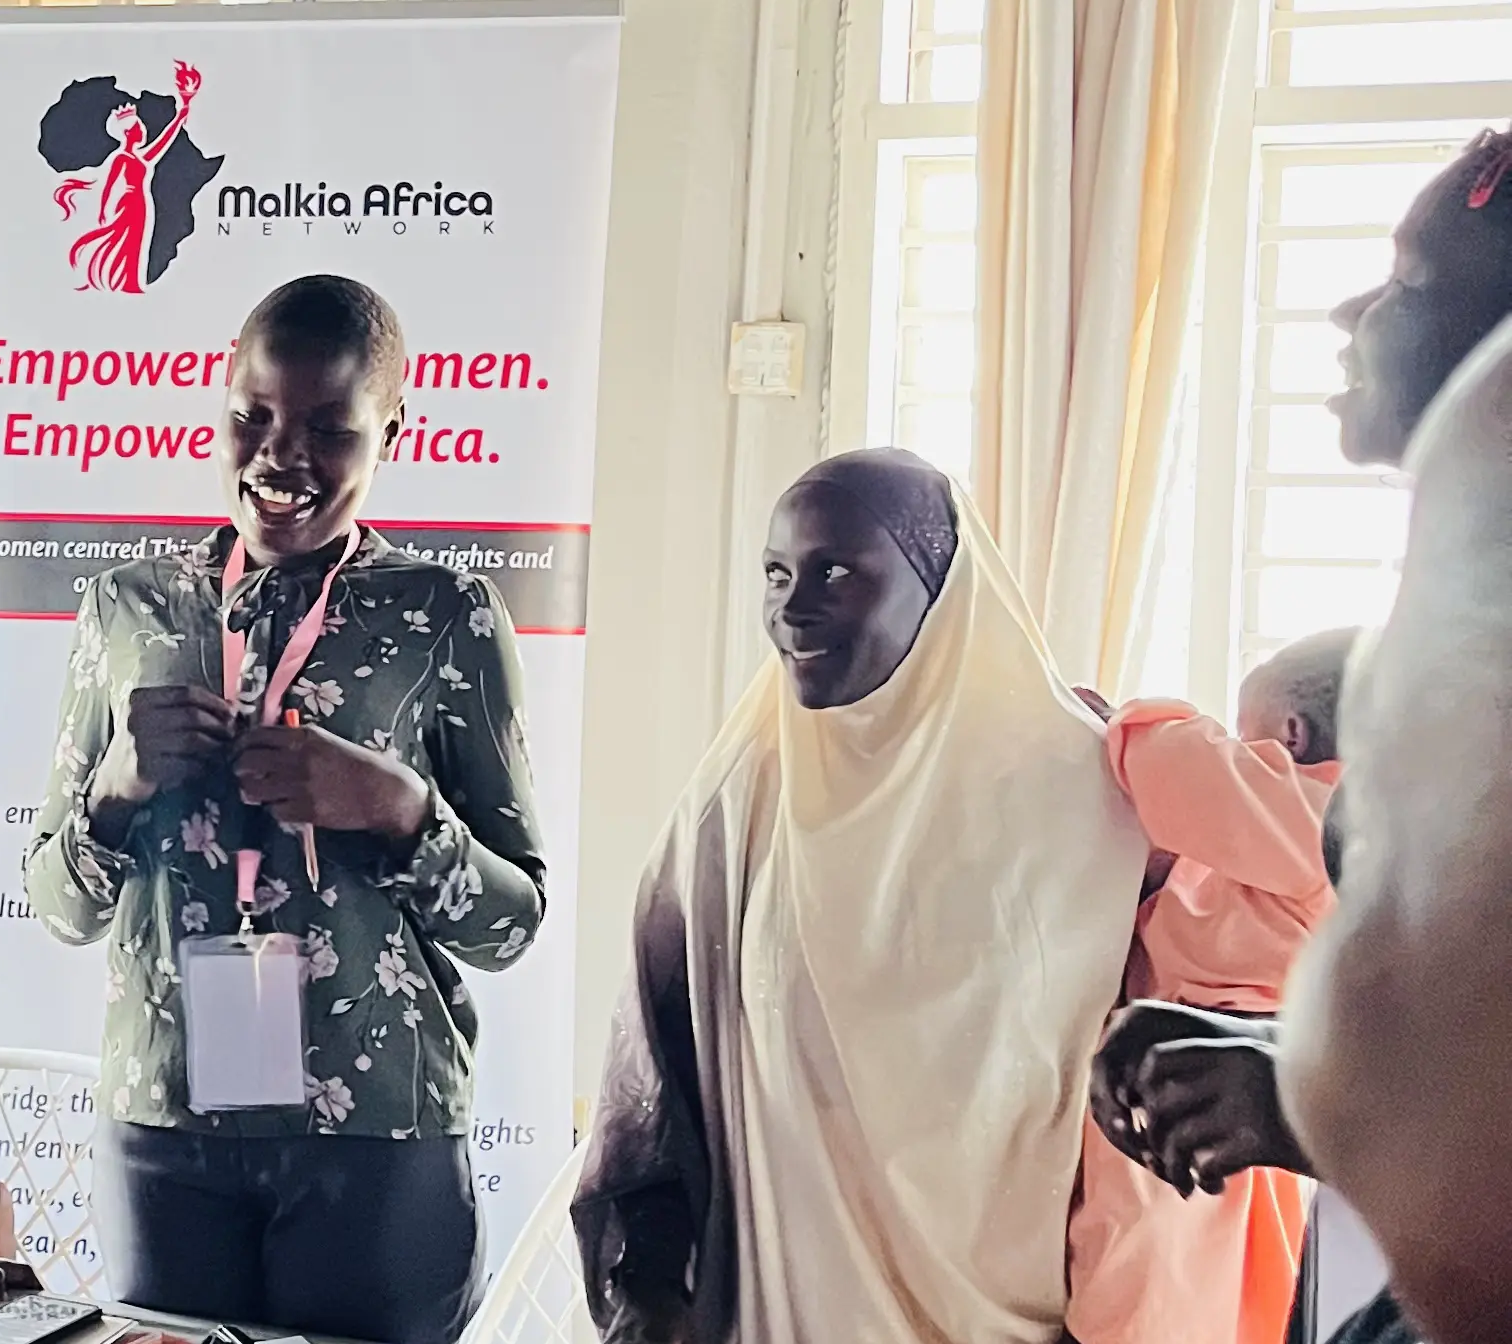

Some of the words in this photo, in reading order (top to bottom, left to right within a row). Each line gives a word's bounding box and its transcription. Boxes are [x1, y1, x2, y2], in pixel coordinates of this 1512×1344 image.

[218, 182, 351, 217] Malkia
[363, 181, 493, 216] Africa
[218, 221, 494, 235] NETWORK
[402, 351, 549, 389] men.
[3, 413, 215, 472] Empowe
[392, 415, 499, 463] rica.
[63, 536, 147, 559] centred
[438, 542, 506, 574] rights
[508, 545, 554, 569] and
[473, 1117, 536, 1151] ights
